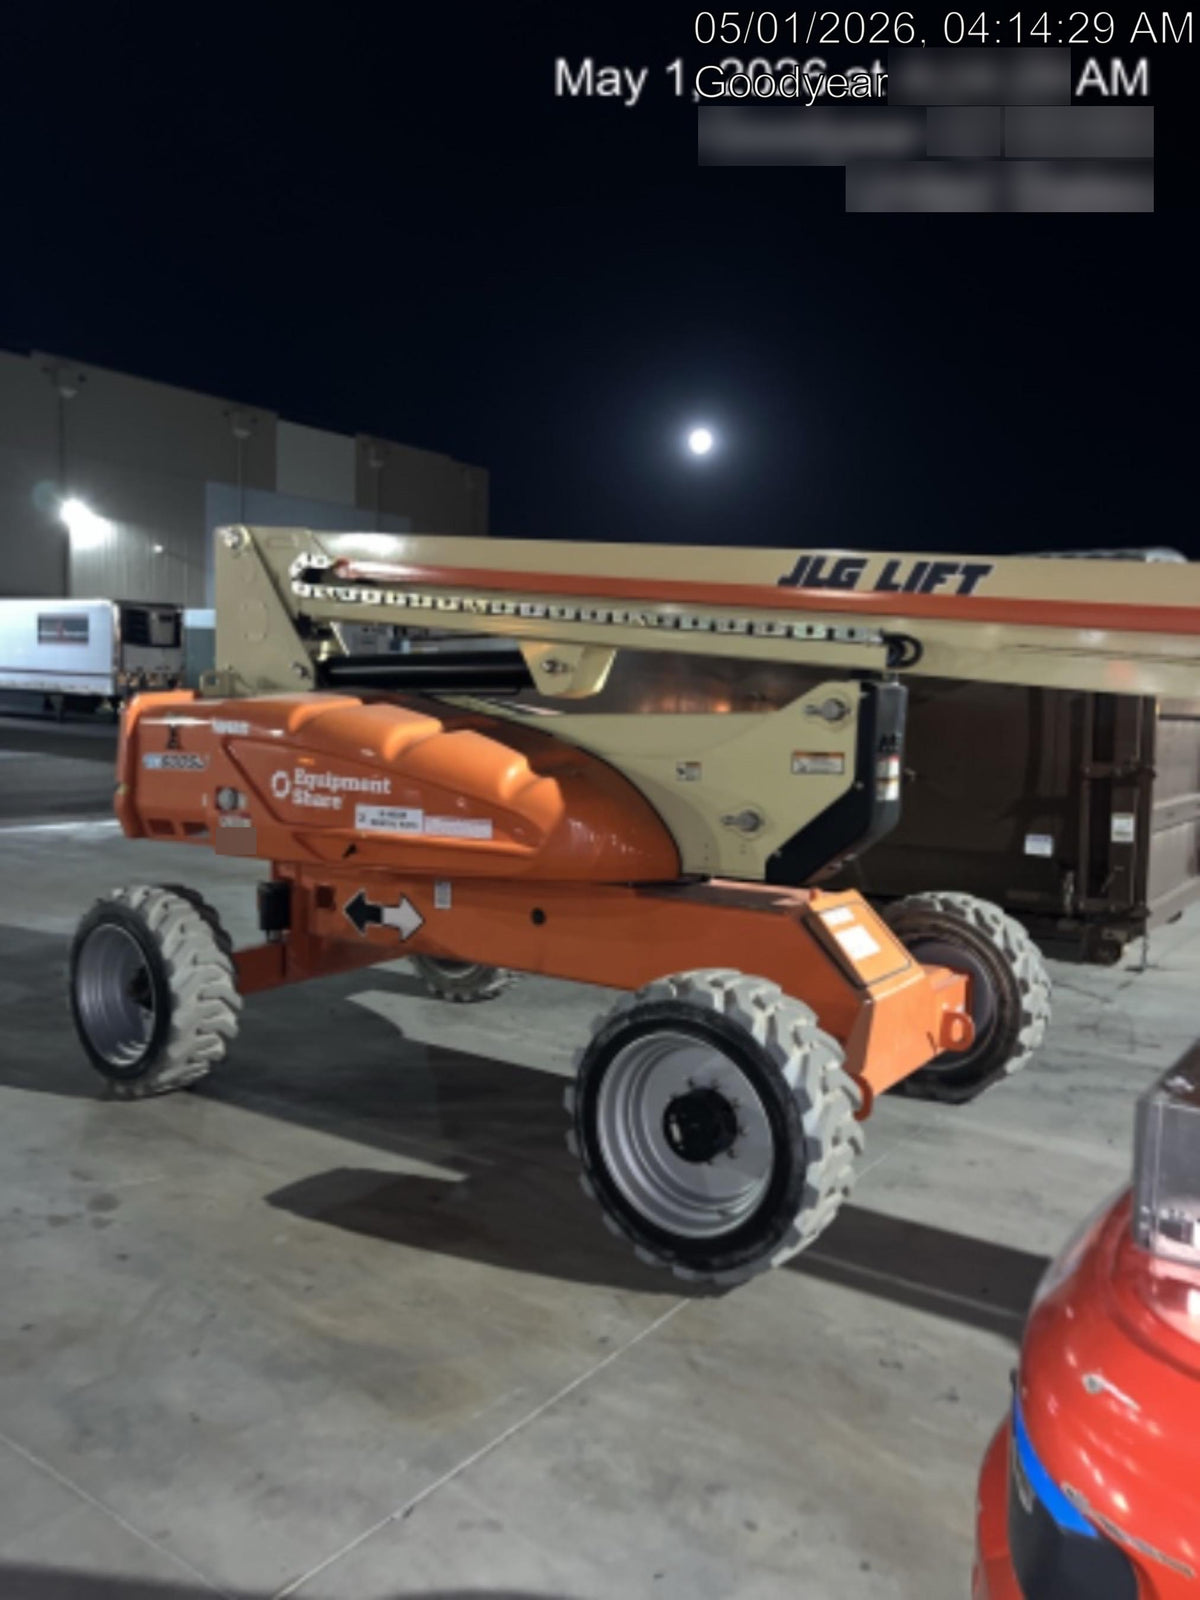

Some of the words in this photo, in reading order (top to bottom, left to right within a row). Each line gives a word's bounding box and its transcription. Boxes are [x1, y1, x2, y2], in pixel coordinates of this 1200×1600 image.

[777, 555, 869, 591] JLG
[873, 559, 995, 597] LIFT
[294, 766, 392, 796] Equipment
[292, 787, 343, 811] Share
